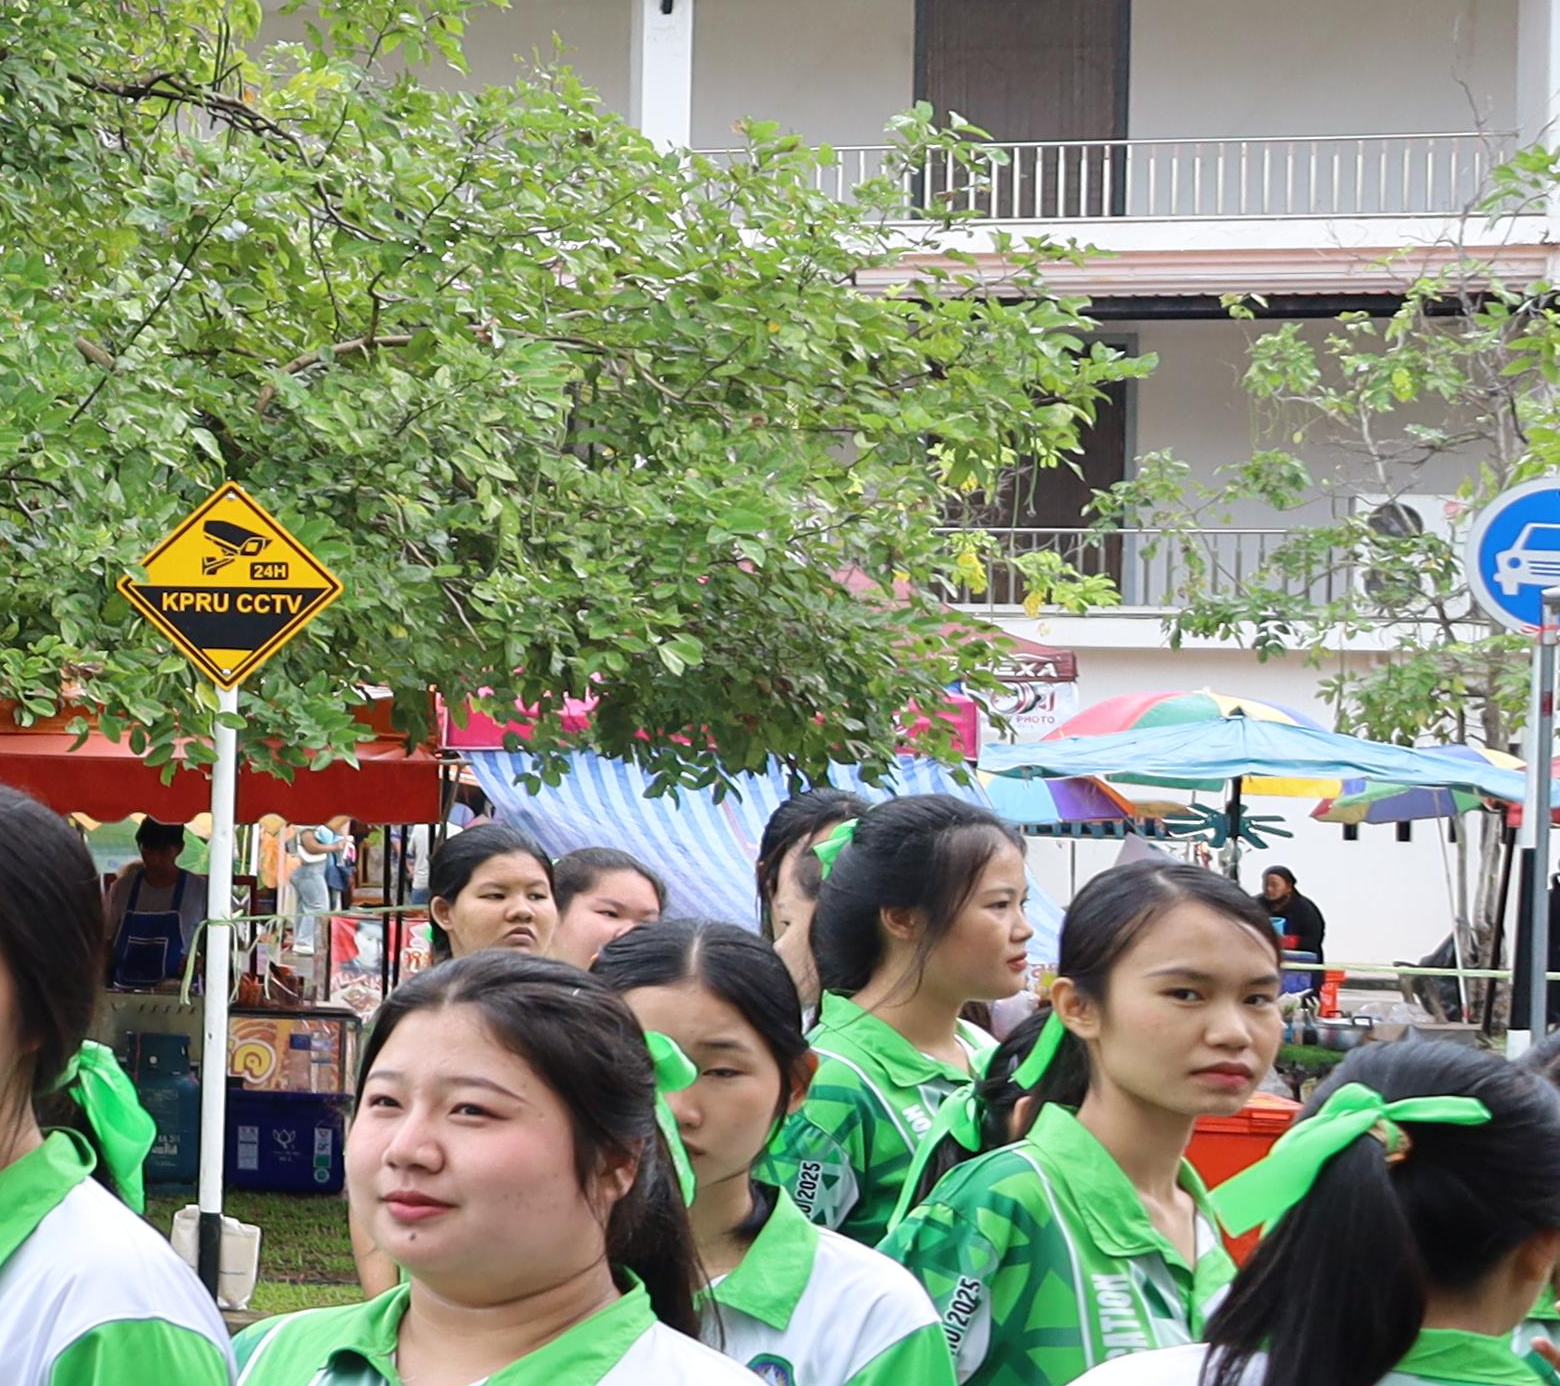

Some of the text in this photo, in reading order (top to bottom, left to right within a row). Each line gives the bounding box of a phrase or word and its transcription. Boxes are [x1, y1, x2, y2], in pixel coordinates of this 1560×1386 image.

[254, 564, 287, 579] 24H
[162, 592, 303, 614] KPRU CCTV
[797, 1162, 821, 1200] 2025
[948, 1277, 981, 1327] 2025
